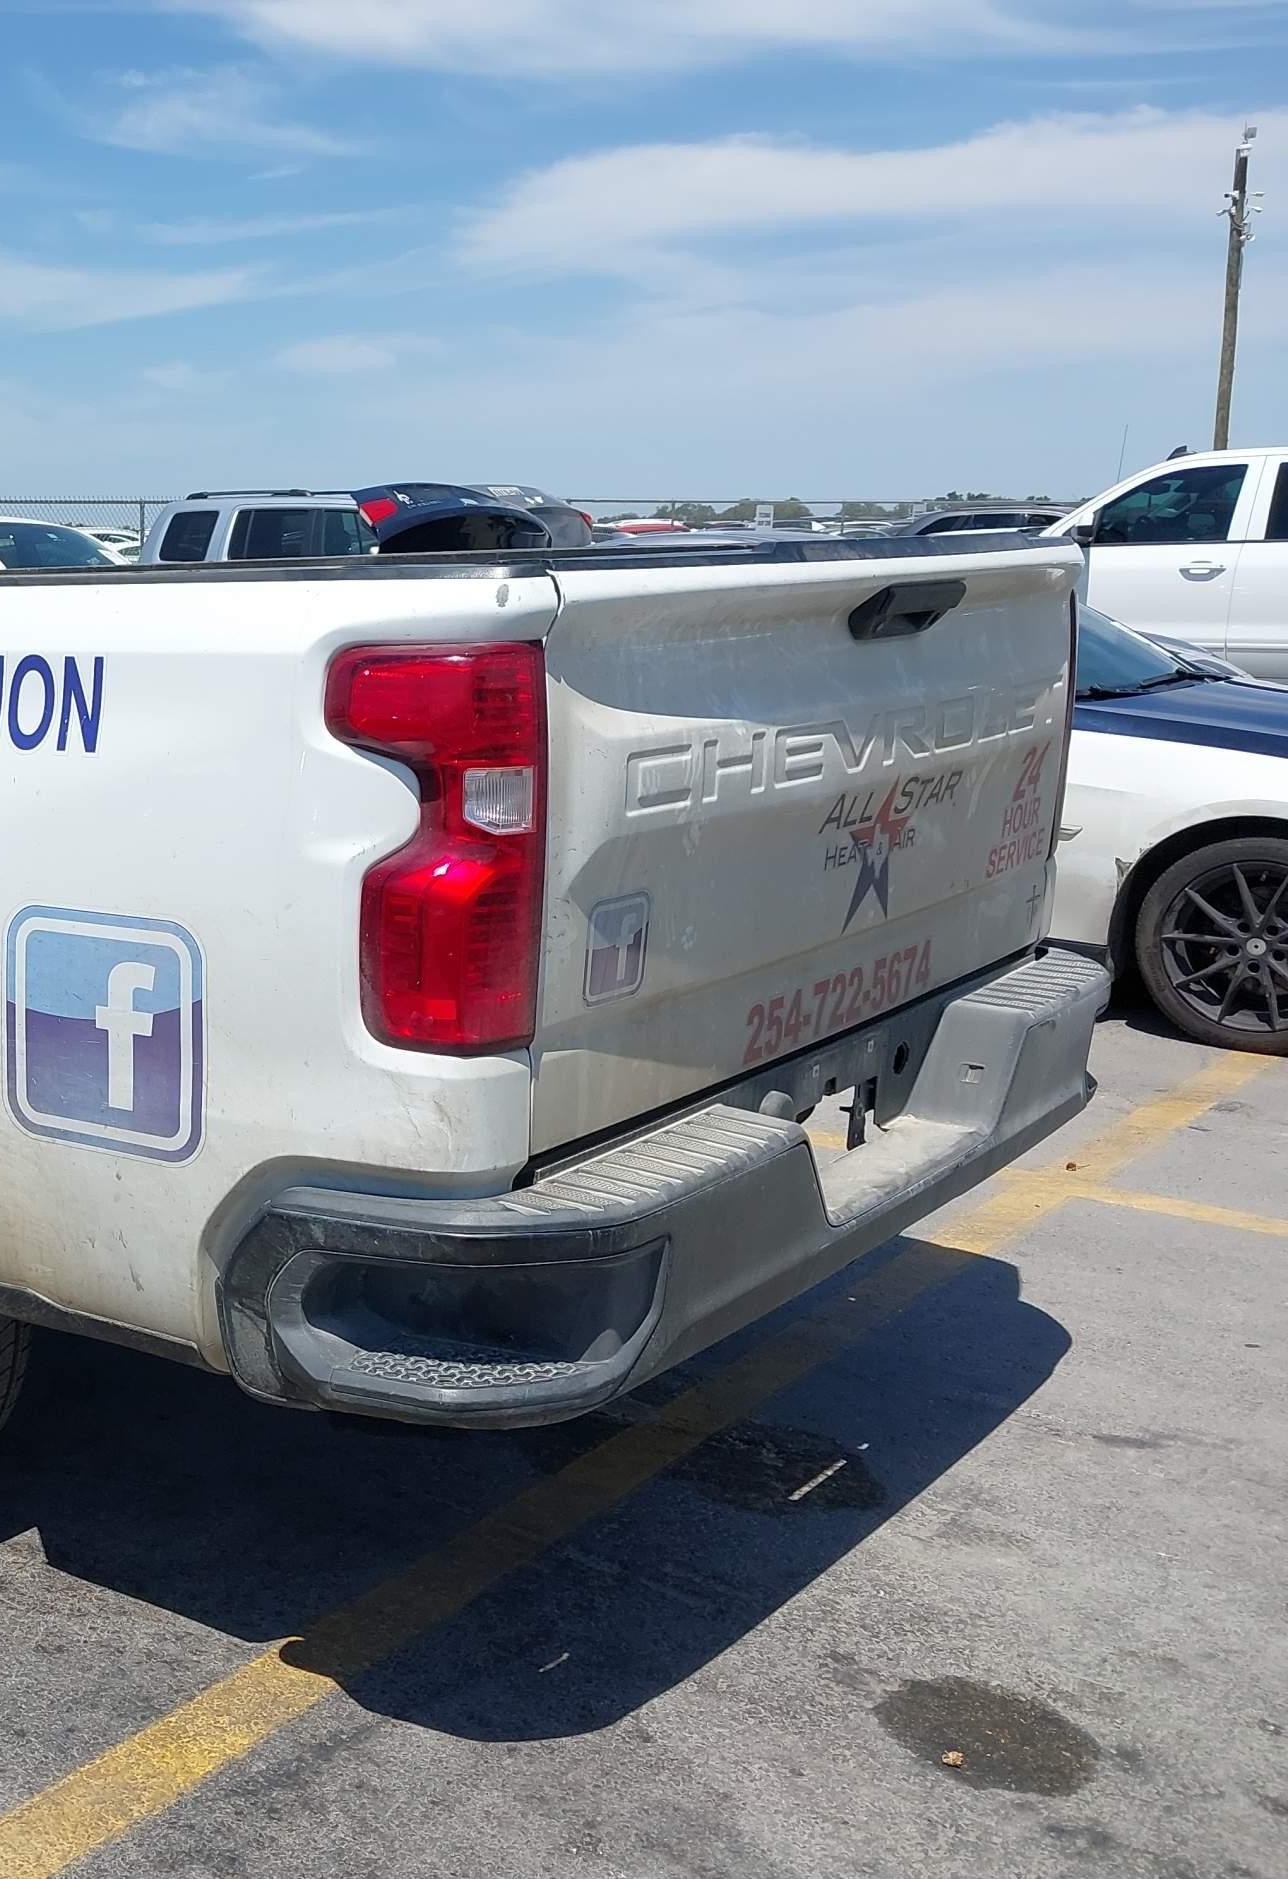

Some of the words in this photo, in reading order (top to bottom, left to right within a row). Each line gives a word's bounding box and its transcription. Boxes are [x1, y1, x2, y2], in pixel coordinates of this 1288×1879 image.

[1013, 741, 1052, 802] 24
[818, 791, 874, 834] ALL
[894, 770, 964, 814] STAR
[1001, 798, 1041, 838] HOUR
[824, 840, 872, 871] HEAT
[891, 828, 915, 852] AIR
[985, 828, 1045, 879] SERVICE
[742, 939, 932, 1064] 254-722-5674
